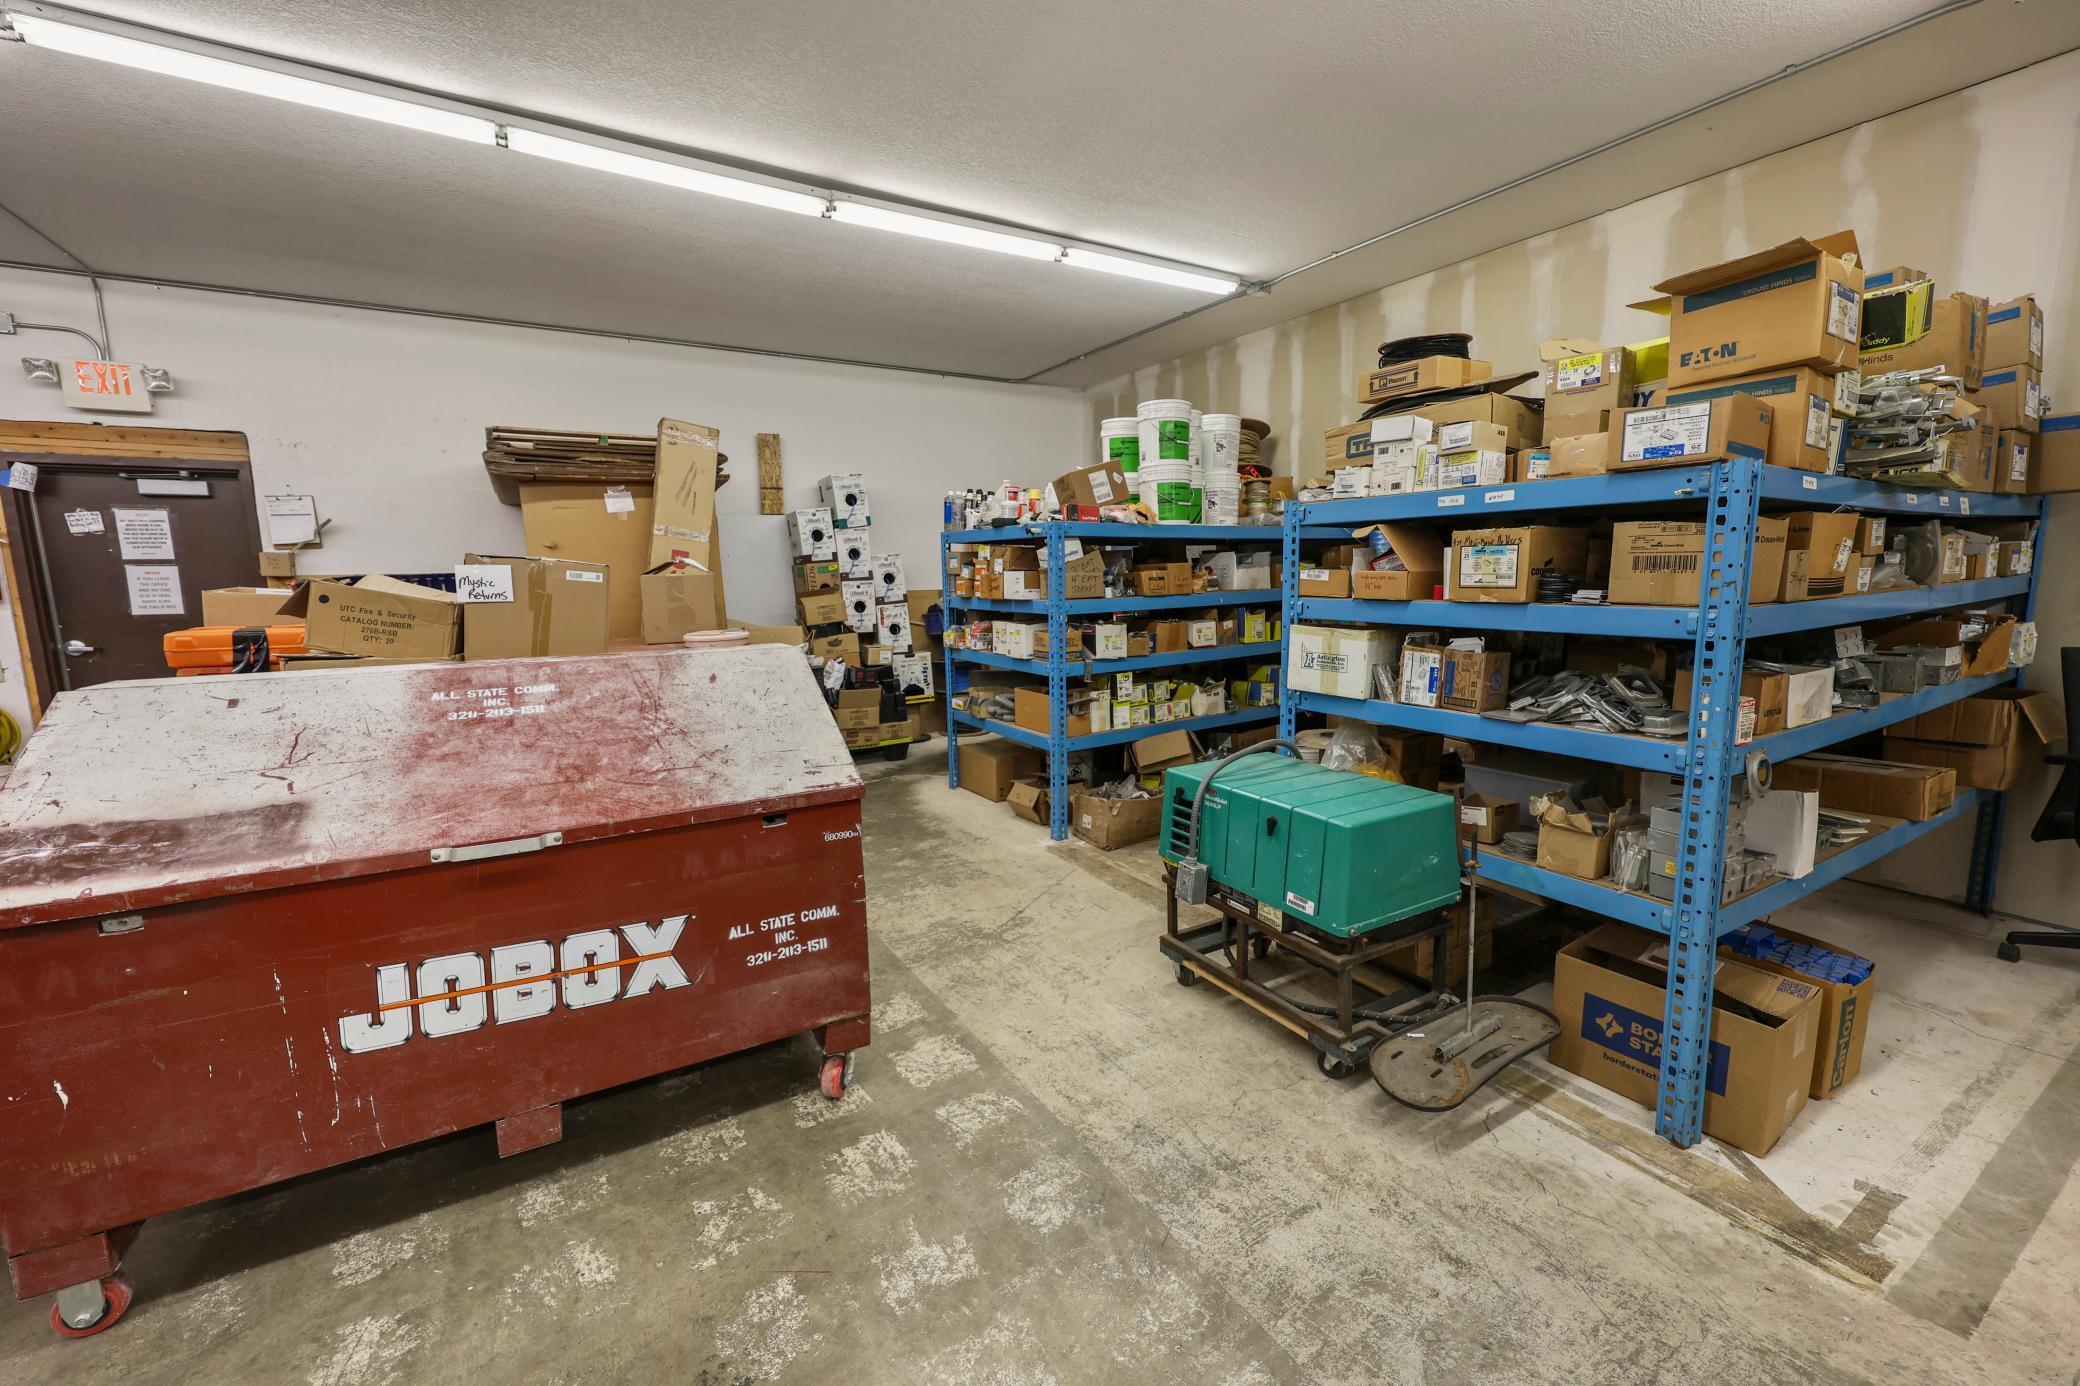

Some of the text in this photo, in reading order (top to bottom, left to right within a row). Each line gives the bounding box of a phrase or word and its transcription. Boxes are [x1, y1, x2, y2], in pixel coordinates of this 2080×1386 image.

[1743, 278, 1793, 297] CROUSE-HINDS
[75, 361, 132, 396] EXIT
[459, 576, 496, 589] Mystic
[468, 589, 508, 601] Returns
[340, 604, 417, 621] UTC Fire & Security
[340, 615, 415, 631] CATALOG NUMBER:
[363, 635, 395, 645] QTY: 20
[1317, 654, 1345, 663] Arlington
[431, 683, 560, 701] ALL STATE COMM.
[483, 697, 511, 707] INC.
[447, 705, 545, 721] 320-203-1511
[728, 904, 840, 940] ALL STATE COMM.
[775, 930, 799, 944] INC.
[746, 937, 828, 967] 320-203-1511
[338, 914, 695, 1055] JOBOX
[1832, 1002, 1855, 1088] Carlon
